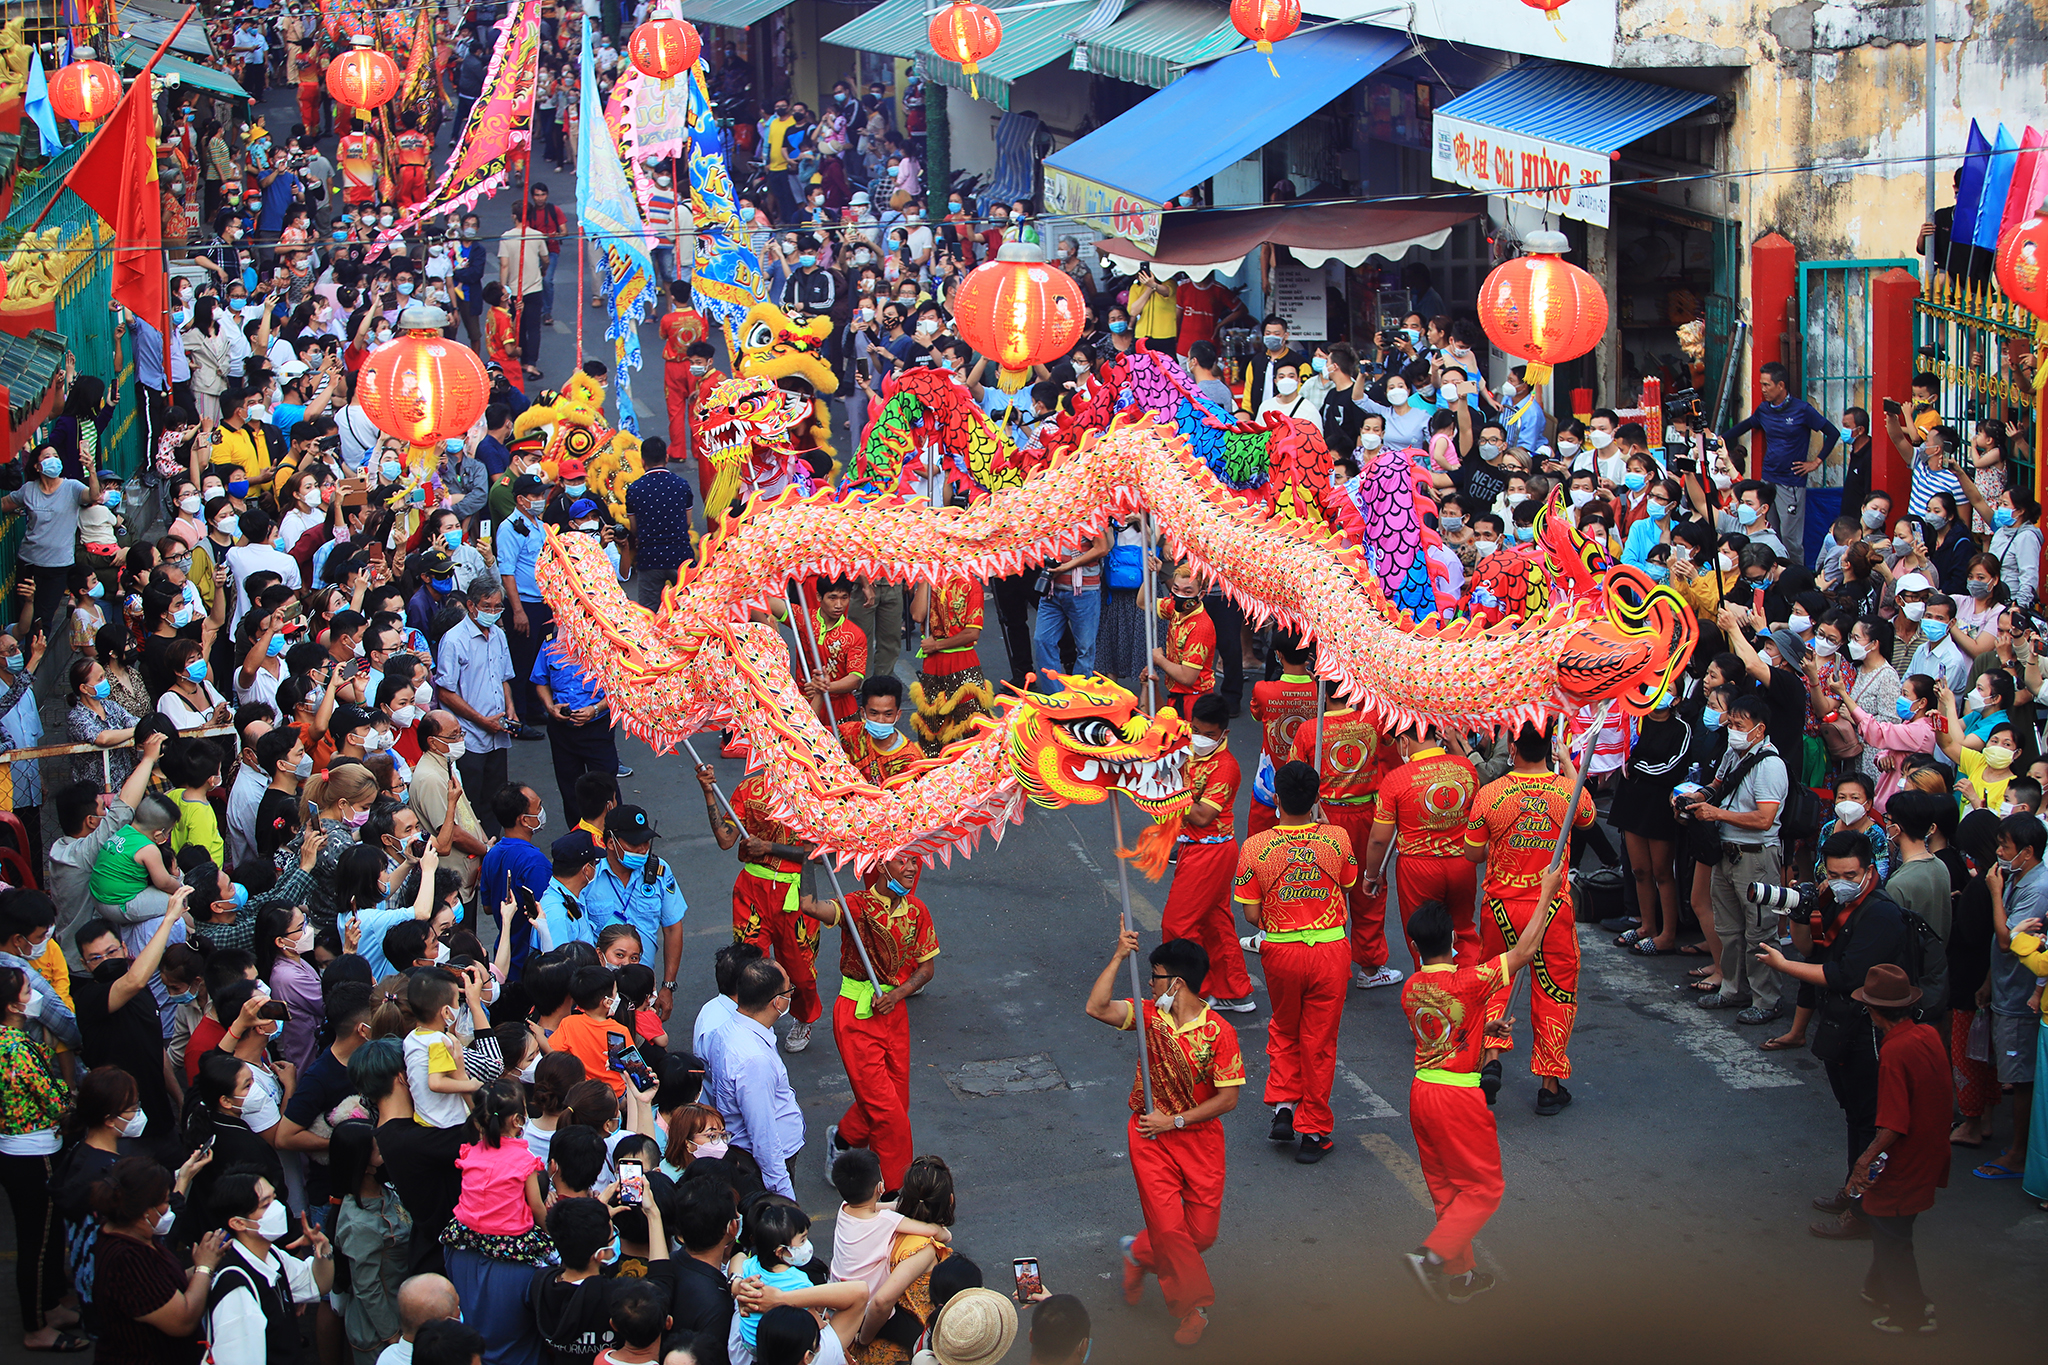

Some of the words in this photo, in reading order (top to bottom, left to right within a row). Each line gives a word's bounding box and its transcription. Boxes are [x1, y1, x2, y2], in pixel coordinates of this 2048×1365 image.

[1113, 195, 1145, 237] 68
[1469, 483, 1496, 501] QUIT
[1516, 816, 1552, 832] Anh
[1508, 833, 1557, 852] Đường
[1284, 866, 1322, 883] Anh
[1278, 885, 1329, 901] Đường
